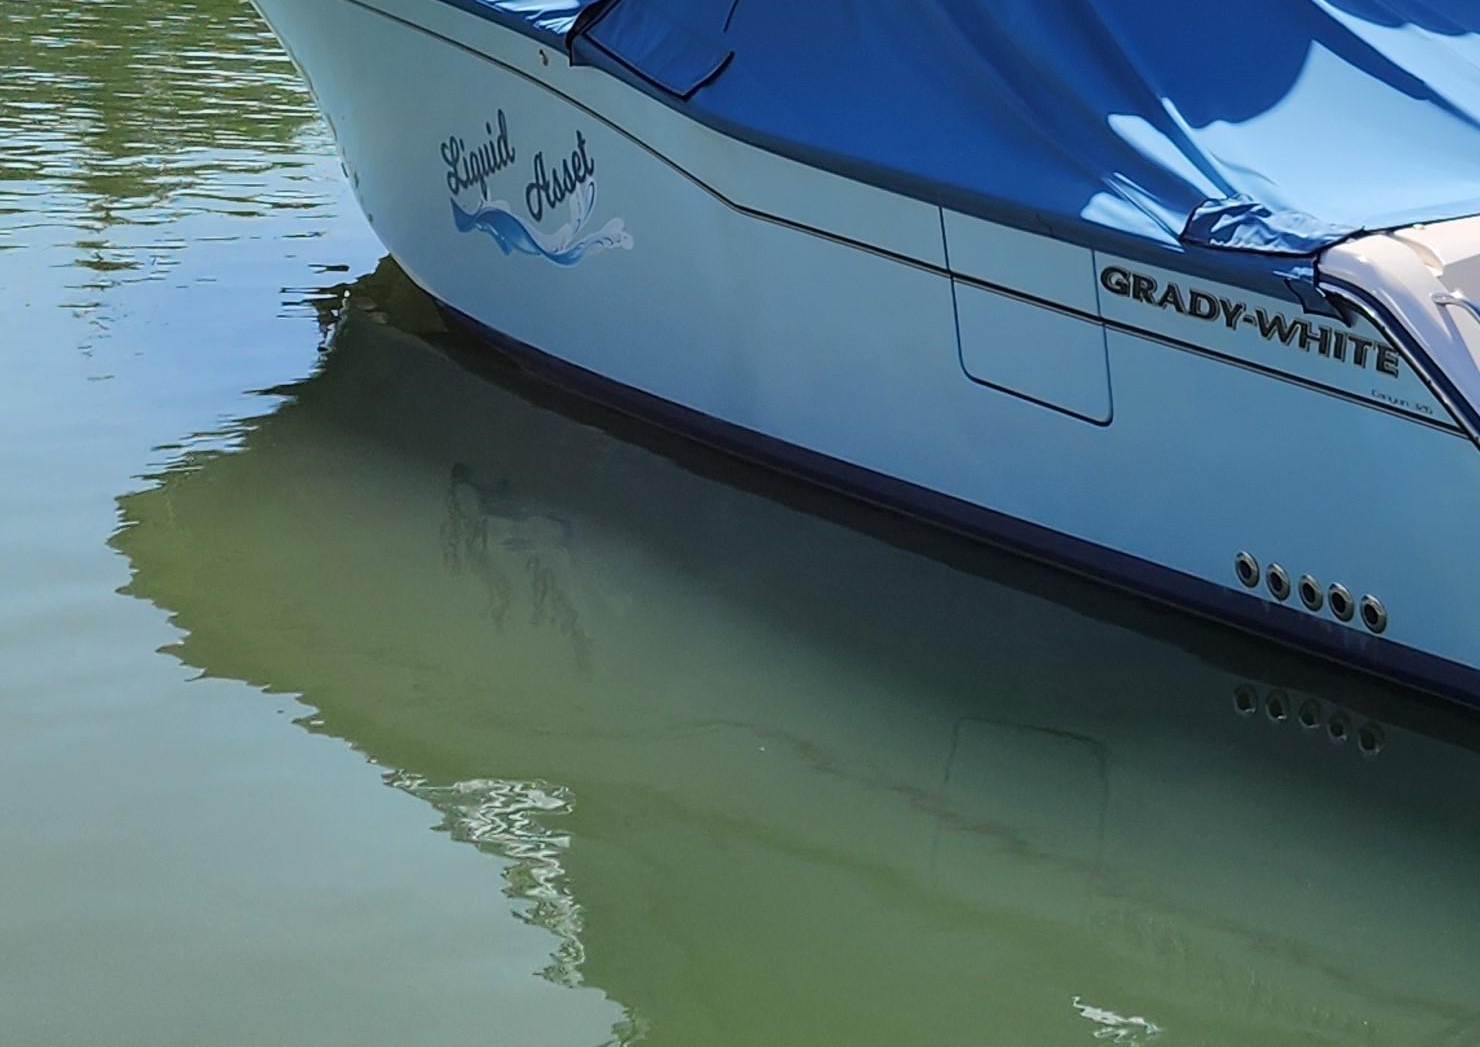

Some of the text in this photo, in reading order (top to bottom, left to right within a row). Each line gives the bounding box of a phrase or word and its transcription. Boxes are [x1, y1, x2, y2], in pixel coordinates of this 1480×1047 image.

[441, 108, 516, 200] Liquid
[525, 130, 595, 222] Asset
[1100, 265, 1400, 378] GRADY-WHITE
